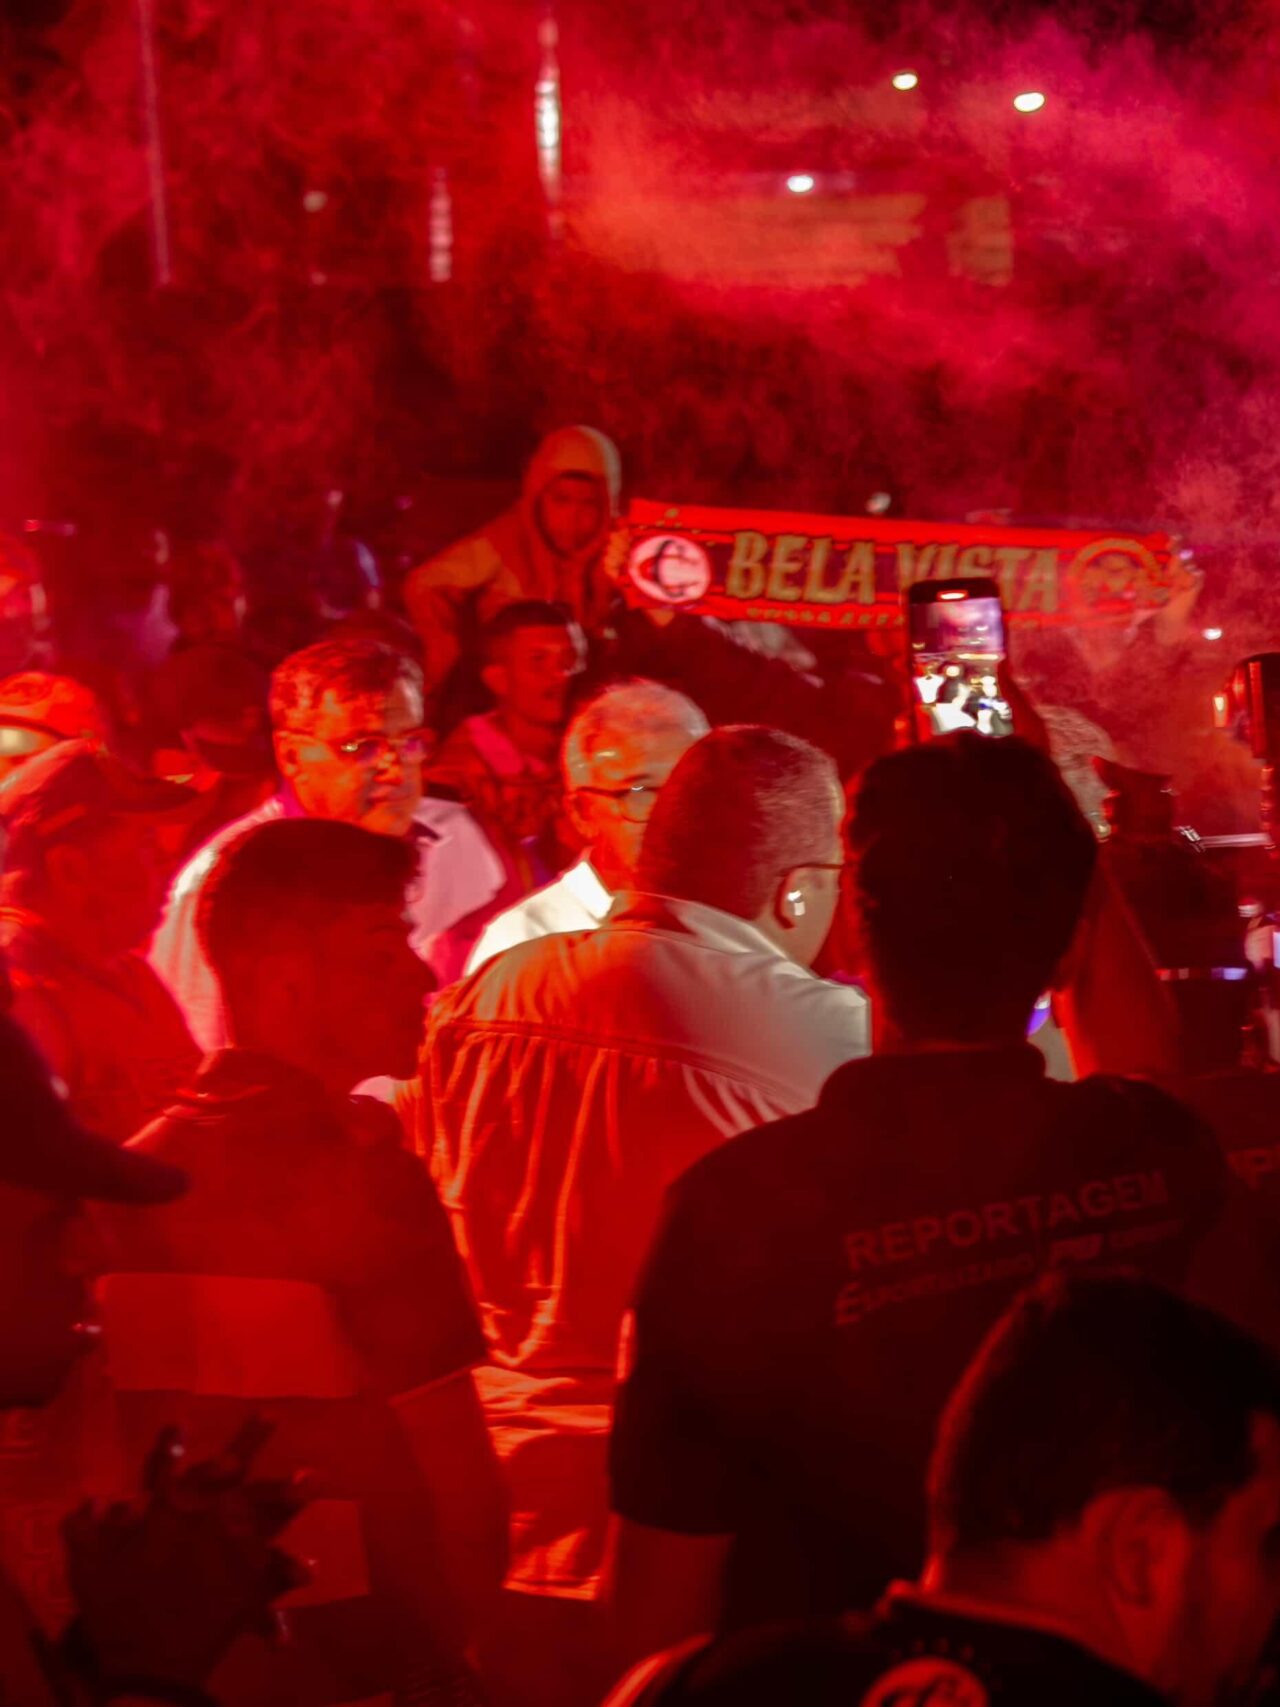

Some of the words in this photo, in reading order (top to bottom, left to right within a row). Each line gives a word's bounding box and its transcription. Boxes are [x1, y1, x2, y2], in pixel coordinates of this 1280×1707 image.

[725, 531, 876, 604] BELA
[895, 541, 1059, 612] VISTA
[843, 1168, 1168, 1272] REPORTAGEM
